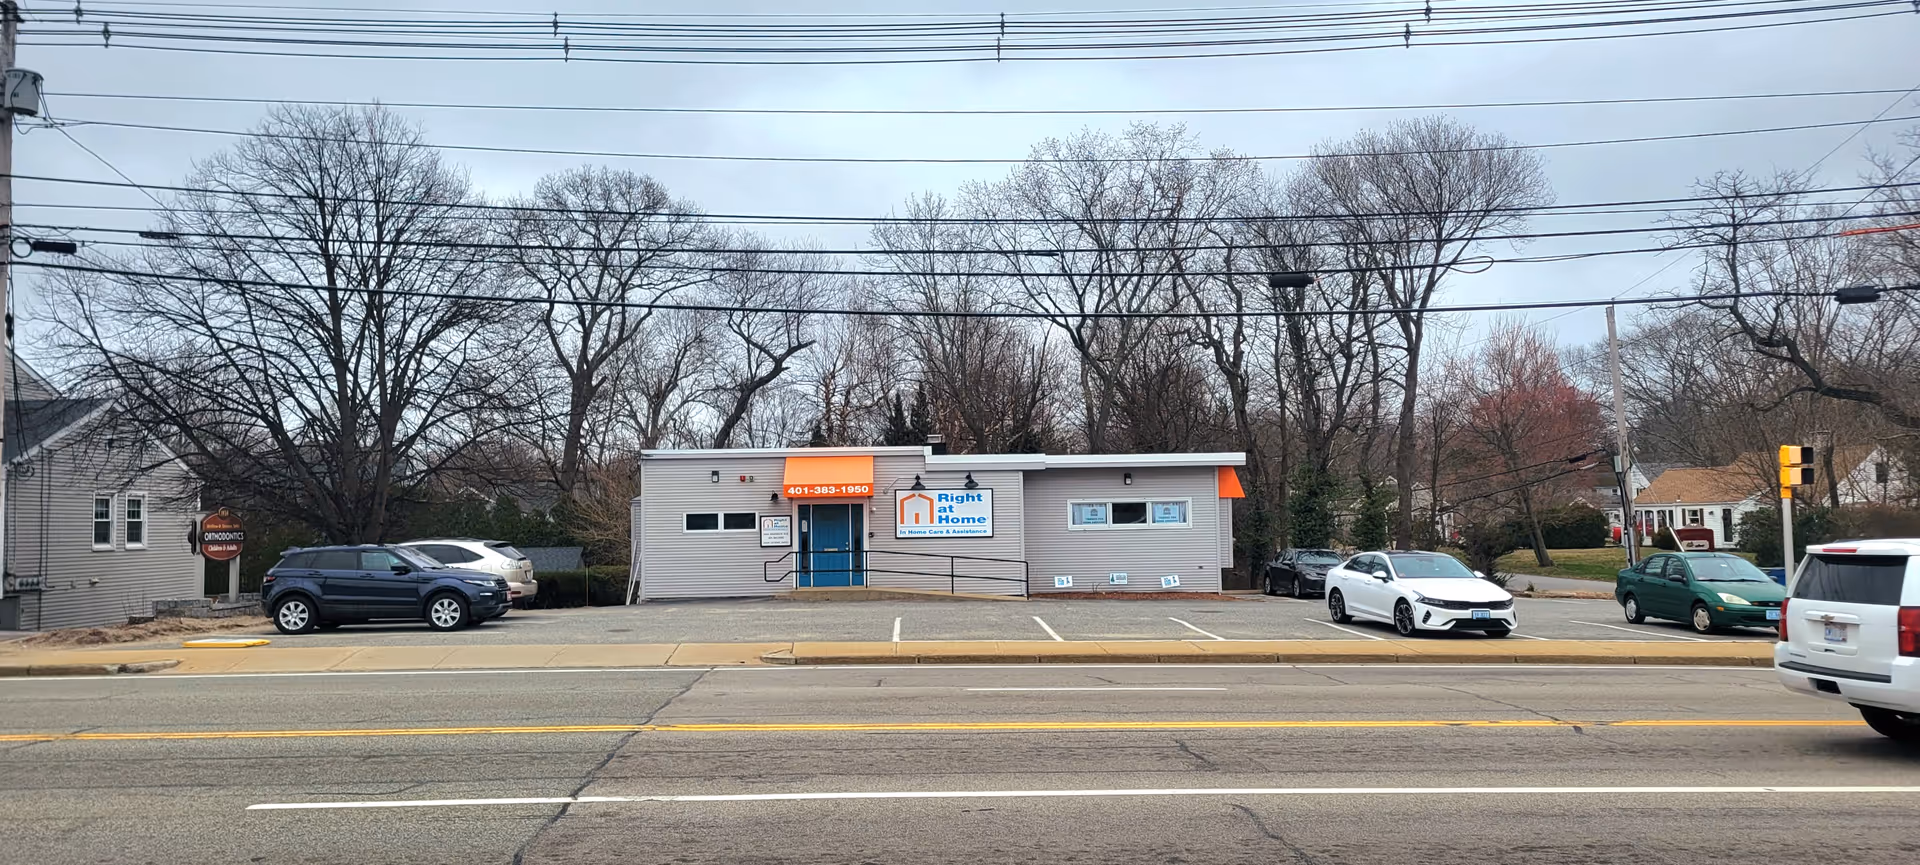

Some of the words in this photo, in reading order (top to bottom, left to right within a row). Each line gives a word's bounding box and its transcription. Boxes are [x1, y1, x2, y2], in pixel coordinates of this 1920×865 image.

[787, 485, 869, 495] 401-383-1950
[937, 493, 983, 504] Right
[937, 504, 954, 513] at
[937, 515, 987, 524] Home
[204, 532, 244, 541] ORTHODONTICS
